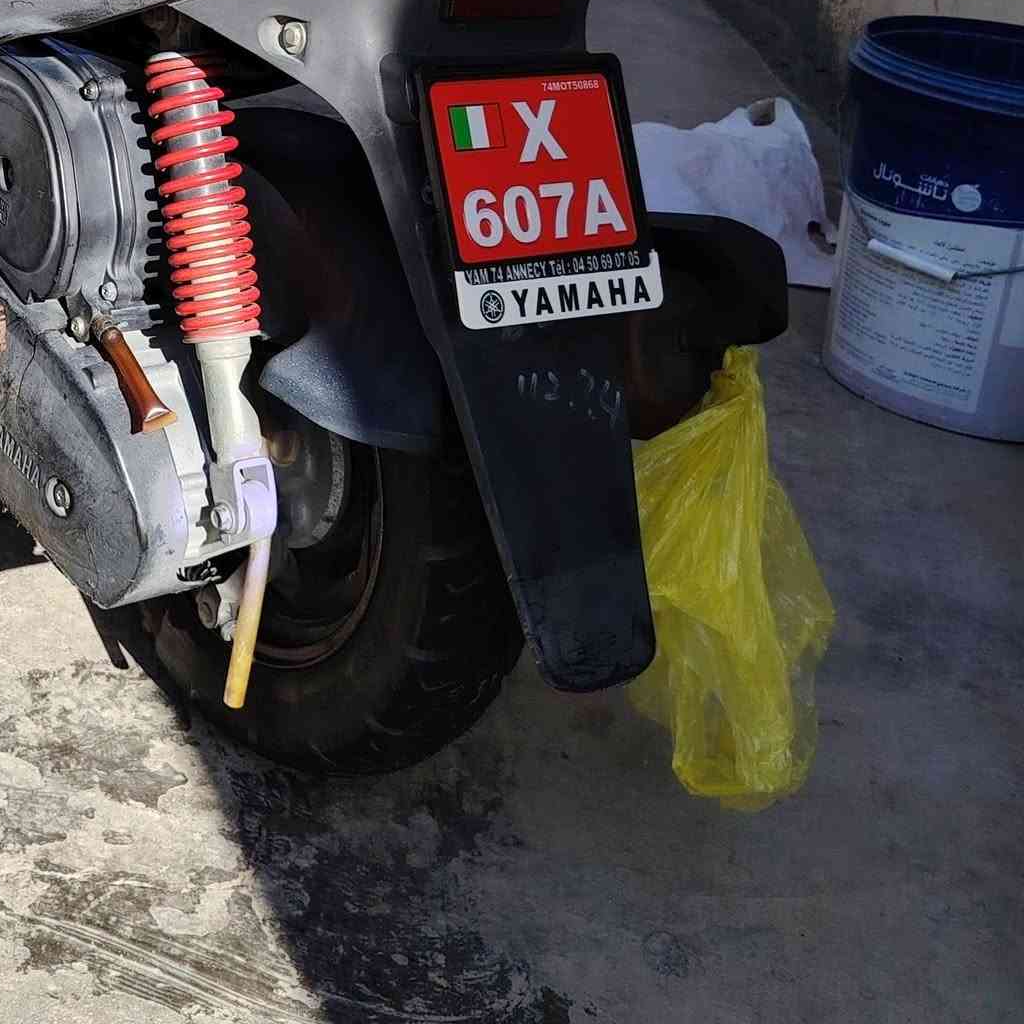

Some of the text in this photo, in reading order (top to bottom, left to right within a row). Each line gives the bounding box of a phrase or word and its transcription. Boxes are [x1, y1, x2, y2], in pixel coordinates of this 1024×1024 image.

[512, 99, 568, 163] X
[463, 178, 627, 248] 607A
[465, 268, 489, 284] YAM
[490, 266, 504, 282] 74
[506, 261, 547, 280] ANNECY
[573, 256, 585, 272] 04
[587, 255, 599, 271] 50
[601, 253, 613, 269] 69
[615, 252, 626, 268] 07
[628, 250, 640, 266] 05
[511, 275, 651, 317] YAMAHA
